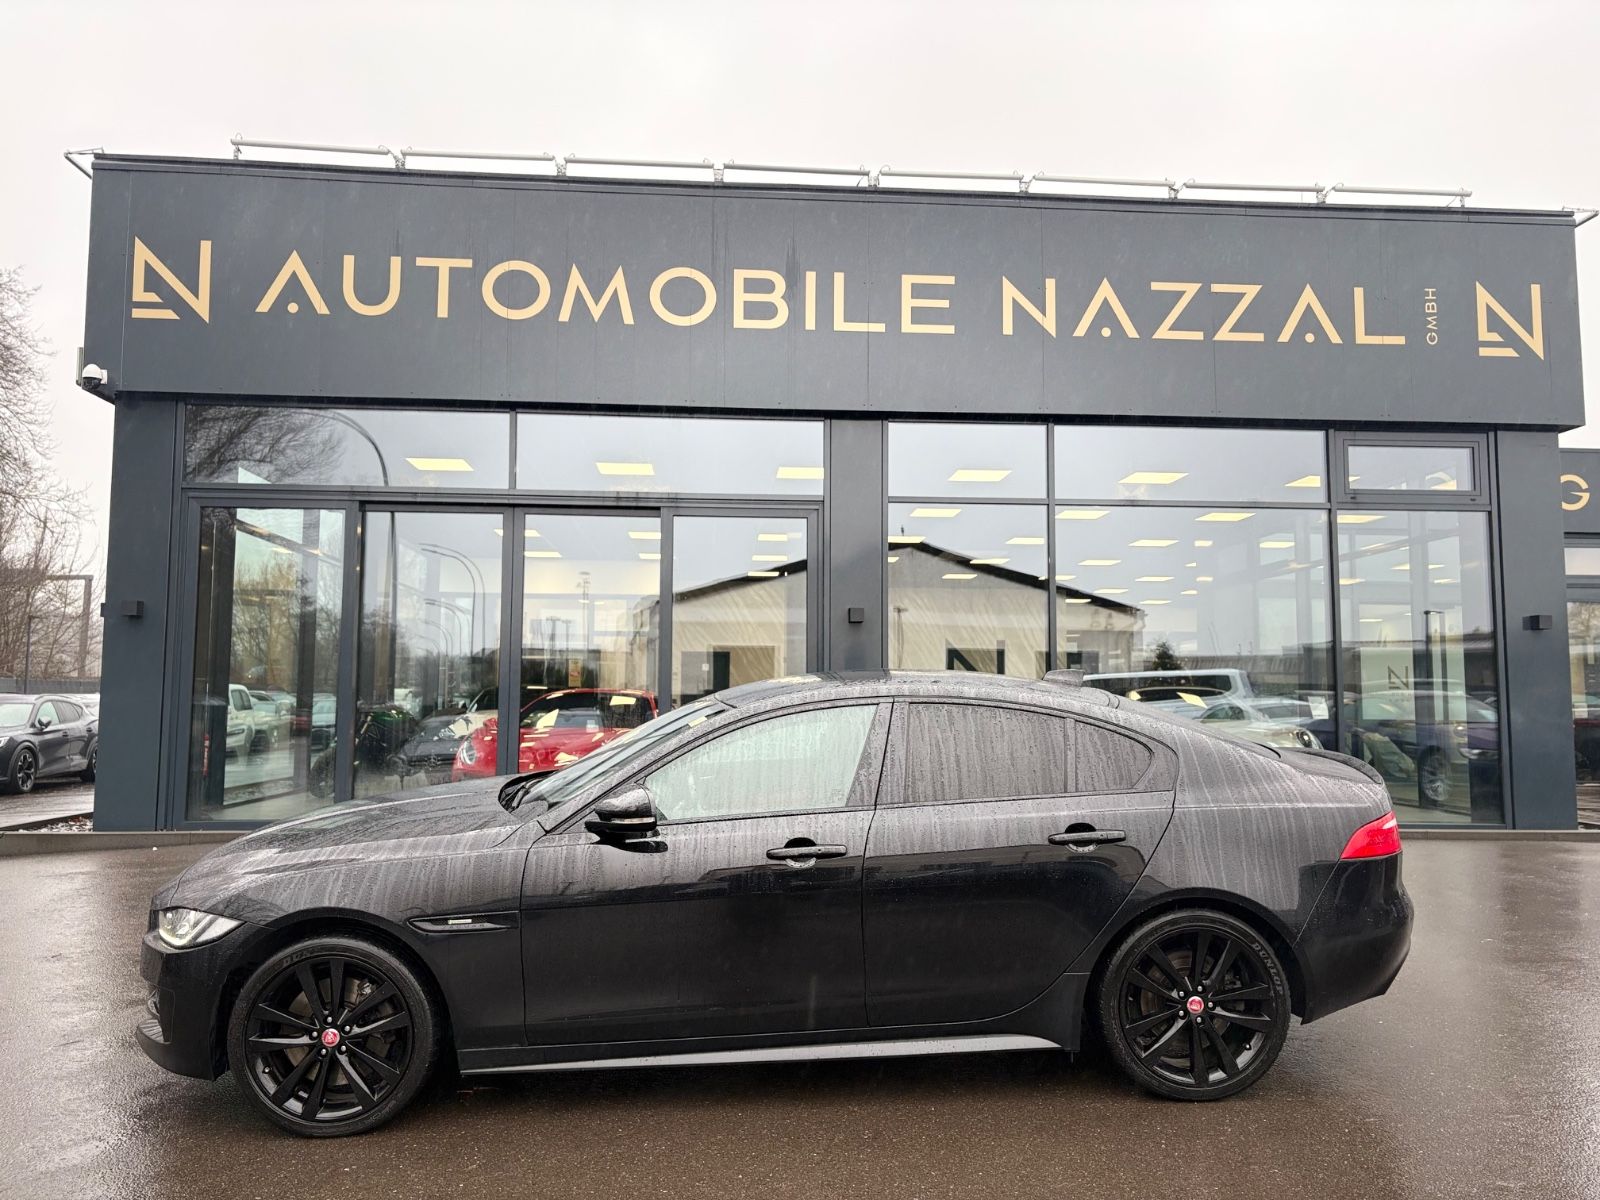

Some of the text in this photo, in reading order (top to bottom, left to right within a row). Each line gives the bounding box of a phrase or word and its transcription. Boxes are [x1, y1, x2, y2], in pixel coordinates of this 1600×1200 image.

[256, 250, 1438, 346] AUTOMOBILE NAZZAL GMBH
[1251, 942, 1283, 994] DUNLOP
